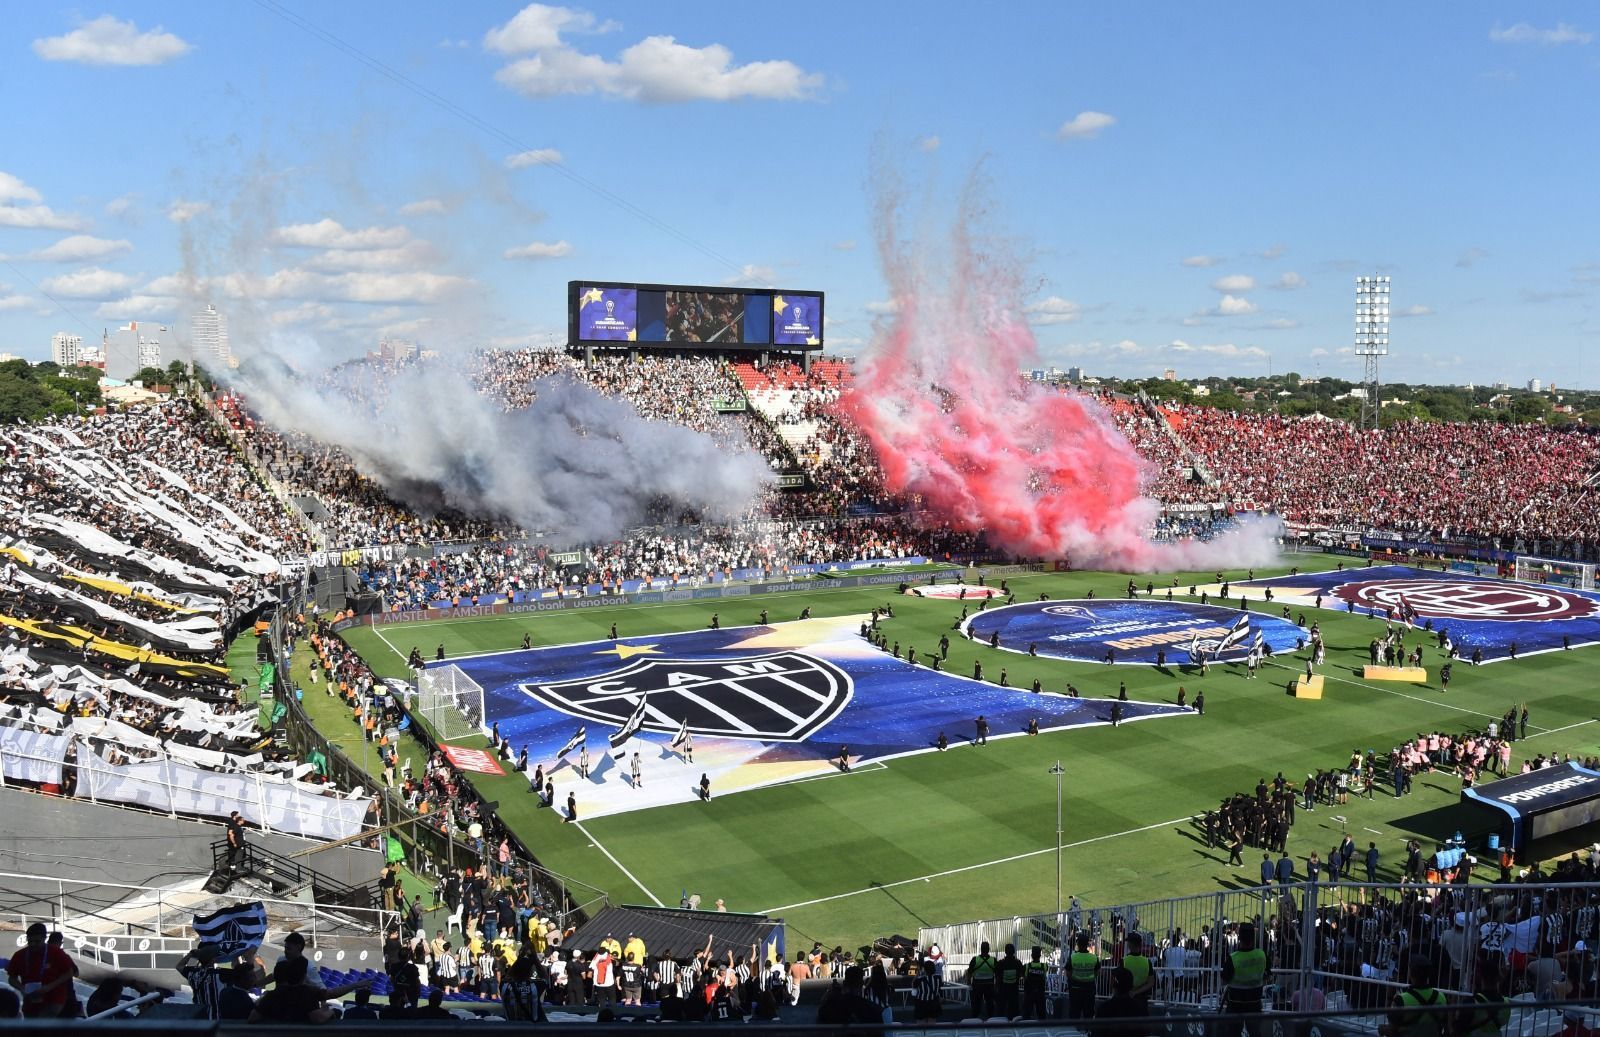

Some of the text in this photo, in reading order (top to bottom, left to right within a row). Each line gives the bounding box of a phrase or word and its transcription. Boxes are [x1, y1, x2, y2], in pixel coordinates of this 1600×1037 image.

[775, 477, 802, 486] ALIDA
[1399, 543, 1446, 552] SUDAMERICANA
[553, 554, 578, 563] SALIDA
[994, 562, 1045, 575] mercado libre
[869, 576, 906, 584] CONMEBOL
[508, 598, 566, 614] ueno bank
[573, 595, 629, 609] ueno bank
[383, 610, 432, 623] AMSTEL
[452, 605, 497, 619] AMSTEL
[1048, 617, 1217, 642] SUDAMERICANA
[586, 660, 791, 695] CAM
[1499, 775, 1595, 804] POWERADE
[107, 939, 115, 949] 10
